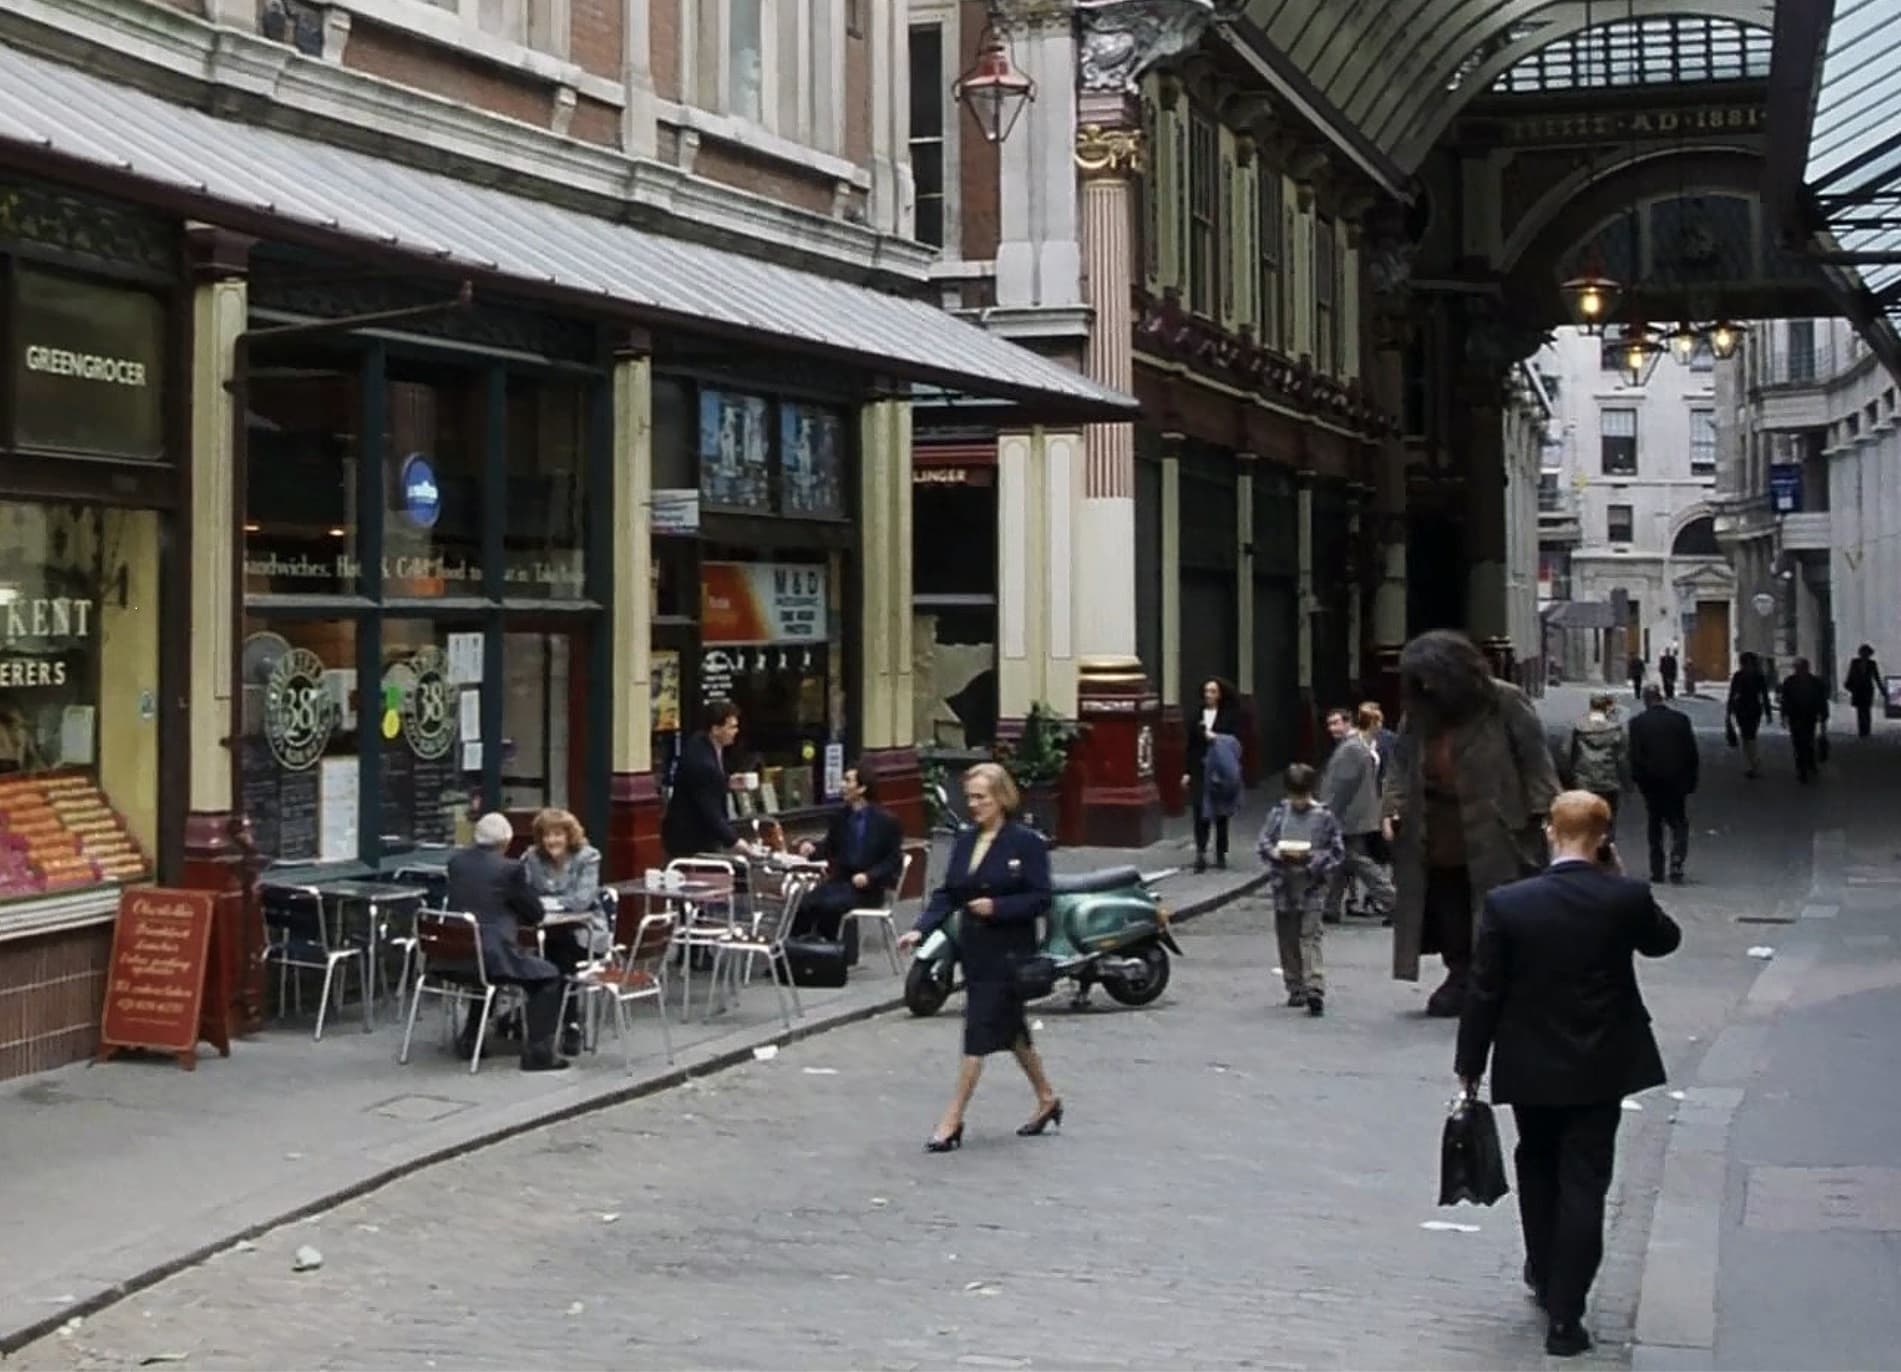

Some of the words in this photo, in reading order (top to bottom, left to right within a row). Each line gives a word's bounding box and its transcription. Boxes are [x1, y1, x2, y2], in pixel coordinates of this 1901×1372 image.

[1697, 107, 1757, 128] 1881
[26, 345, 147, 387] GREENGROCER
[7, 597, 93, 636] KENT
[0, 661, 66, 686] ERERS
[286, 686, 315, 729] 38
[418, 680, 444, 727] 38
